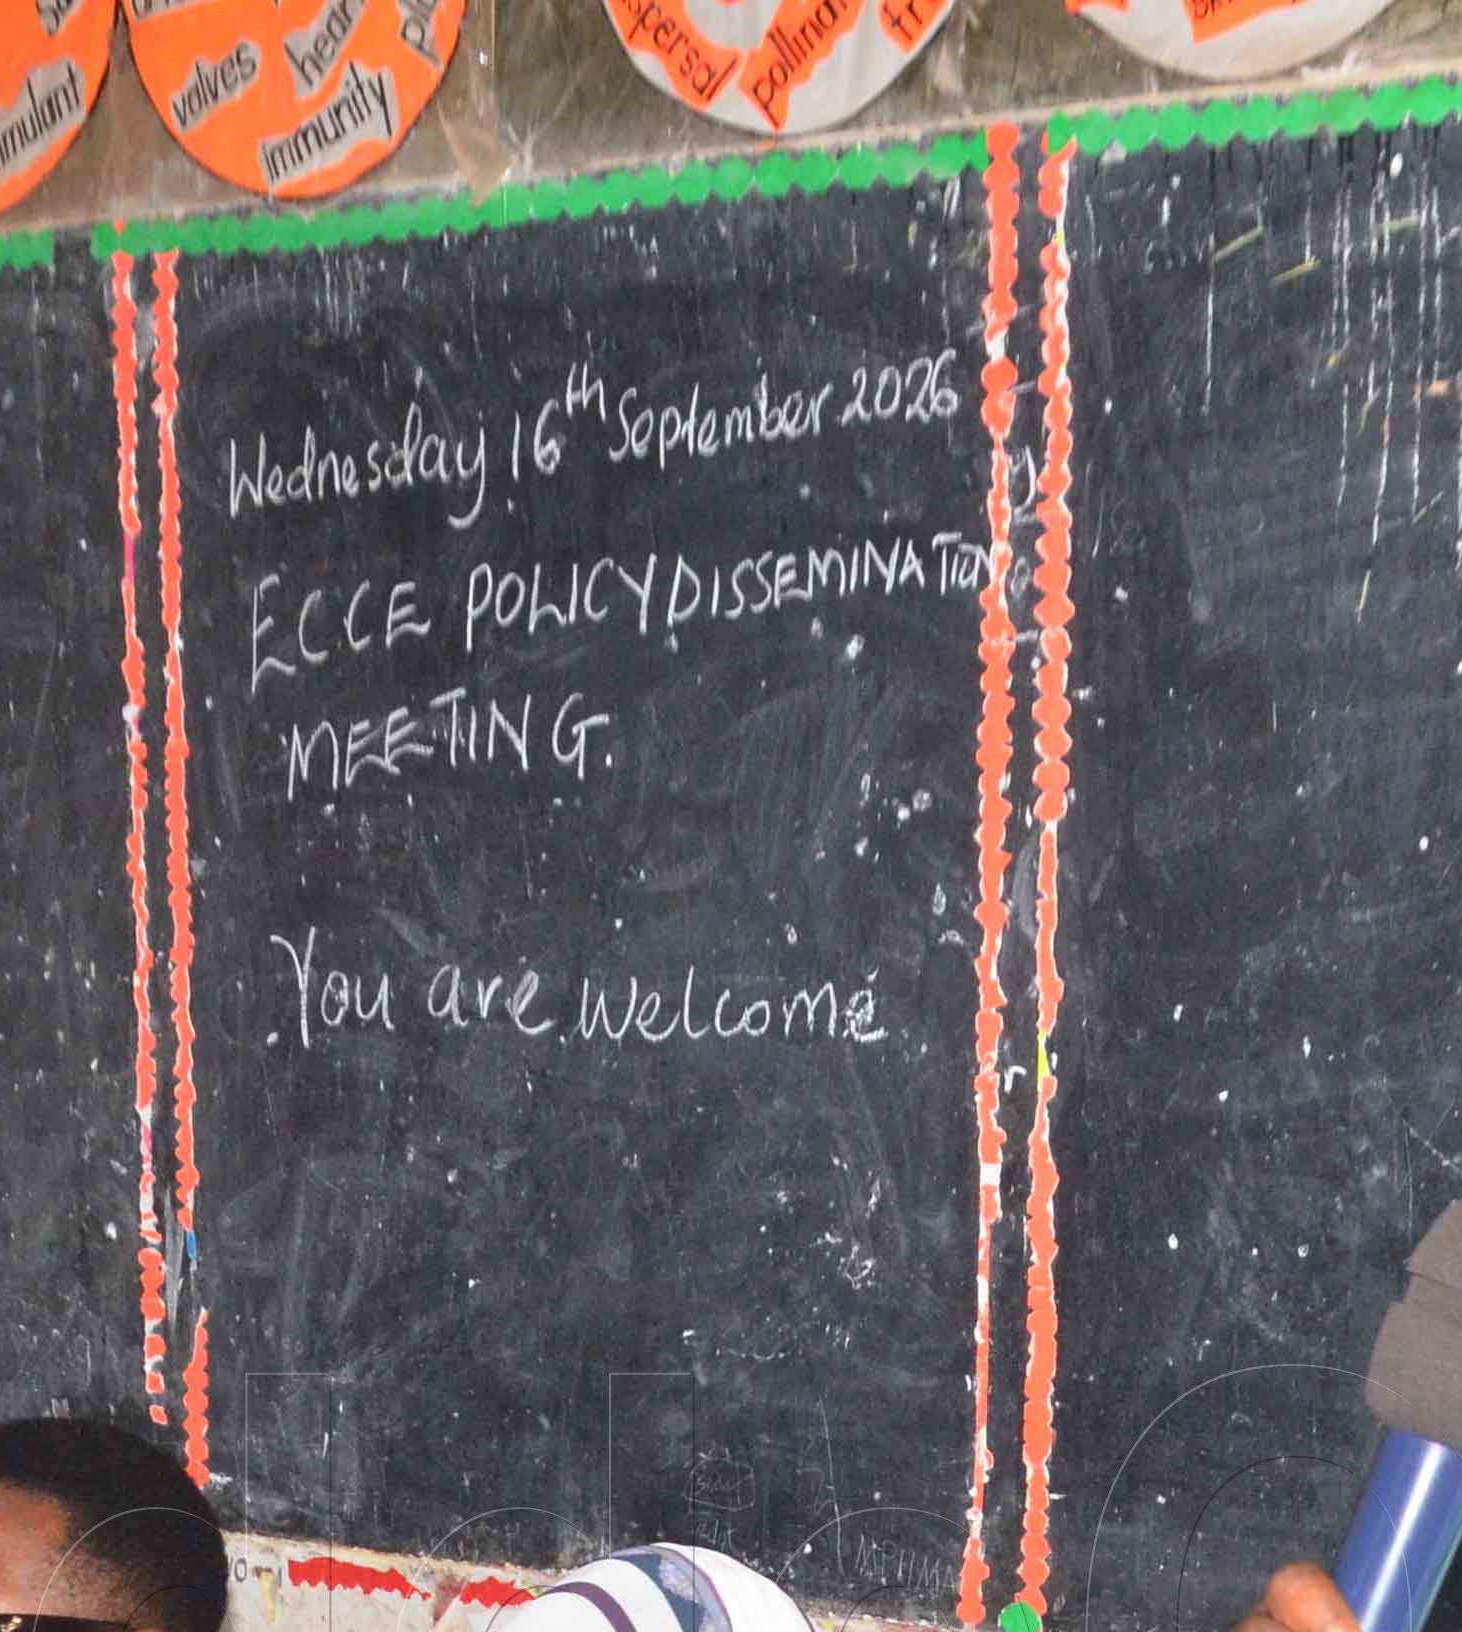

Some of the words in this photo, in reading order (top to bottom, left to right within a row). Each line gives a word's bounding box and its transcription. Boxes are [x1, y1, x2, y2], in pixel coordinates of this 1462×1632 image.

[171, 41, 257, 127] valves
[284, 0, 362, 86] hear
[621, 0, 737, 102] spersal
[752, 0, 847, 128] pollina
[229, 402, 489, 528] Wednesday
[512, 362, 607, 480] 16th
[609, 385, 833, 477] September
[841, 350, 959, 425] 2026
[251, 574, 431, 694] ECCE
[270, 927, 394, 1047] You
[427, 962, 553, 1036] are
